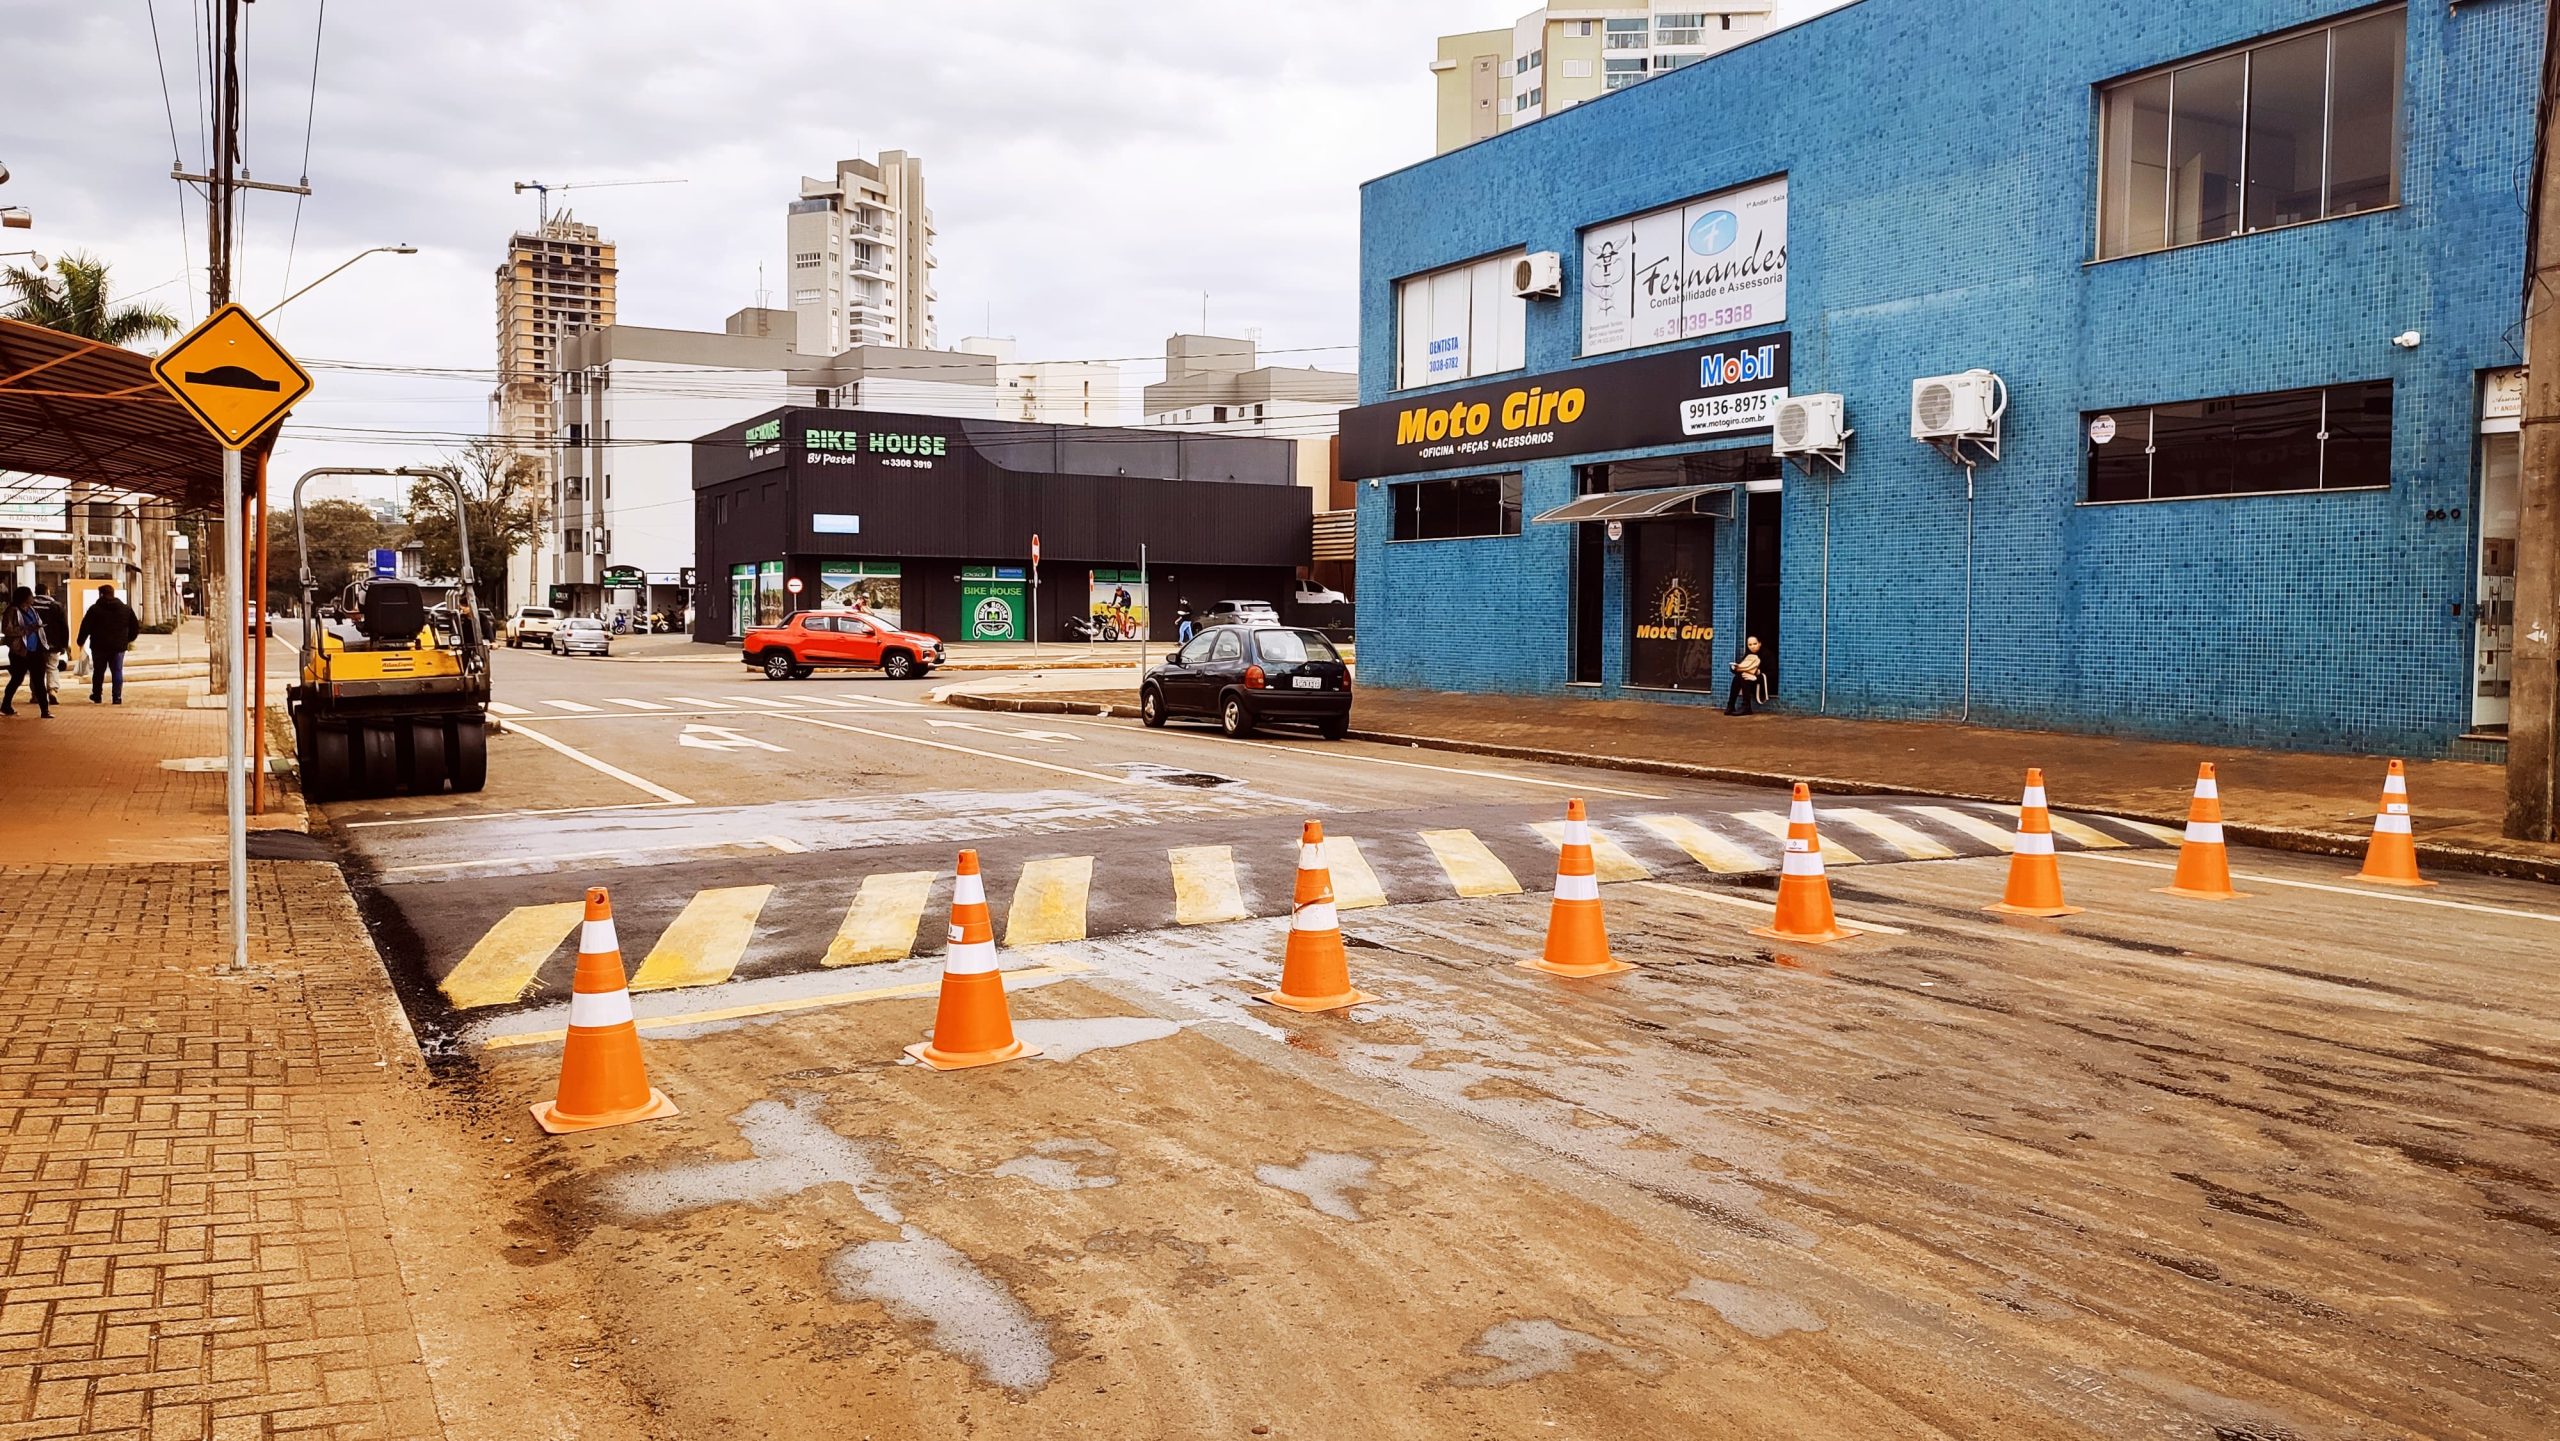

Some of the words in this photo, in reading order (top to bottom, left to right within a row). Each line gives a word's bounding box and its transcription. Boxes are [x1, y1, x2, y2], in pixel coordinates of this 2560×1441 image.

[1636, 229, 1787, 296] Fernandes
[1719, 286, 1725, 296] e
[1727, 272, 1784, 292] Assessoria
[1429, 336, 1459, 356] DENTISTA
[1700, 343, 1775, 389] Mobil
[1396, 401, 1491, 446] Moto
[1501, 386, 1586, 432] Giro
[1689, 394, 1767, 420] 99136-8975
[1690, 413, 1766, 431] www.motogiro.com.br
[806, 429, 857, 451] BIKE
[869, 432, 946, 456] HOUSE
[823, 453, 856, 466] Pastel
[913, 459, 933, 470] 3919
[963, 586, 987, 596] BIKE
[989, 587, 1022, 596] HOUSE
[1681, 624, 1715, 640] Giro
